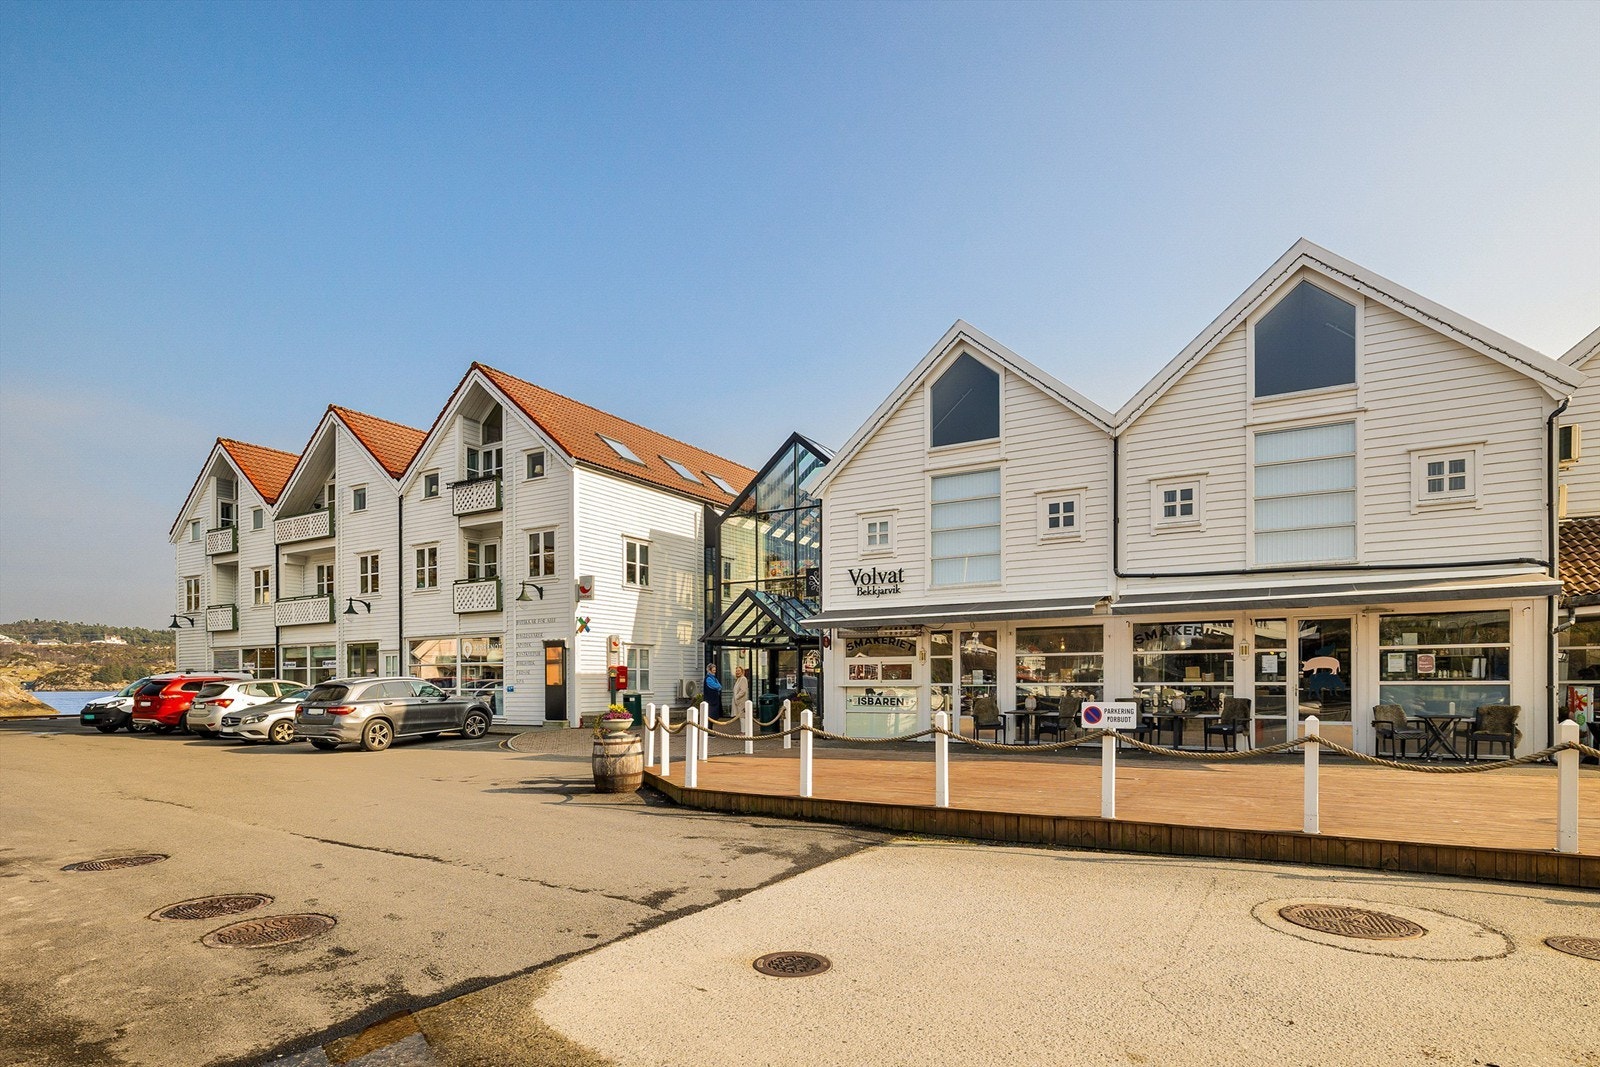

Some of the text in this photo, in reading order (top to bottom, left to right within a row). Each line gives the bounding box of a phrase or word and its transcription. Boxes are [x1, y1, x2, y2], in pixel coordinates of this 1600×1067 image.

[848, 566, 905, 586] Volvat
[857, 584, 901, 598] Bekkjarvik
[1134, 625, 1234, 644] SMAKERIET
[846, 637, 916, 652] SMAKERIET
[858, 697, 904, 706] ISBAREN
